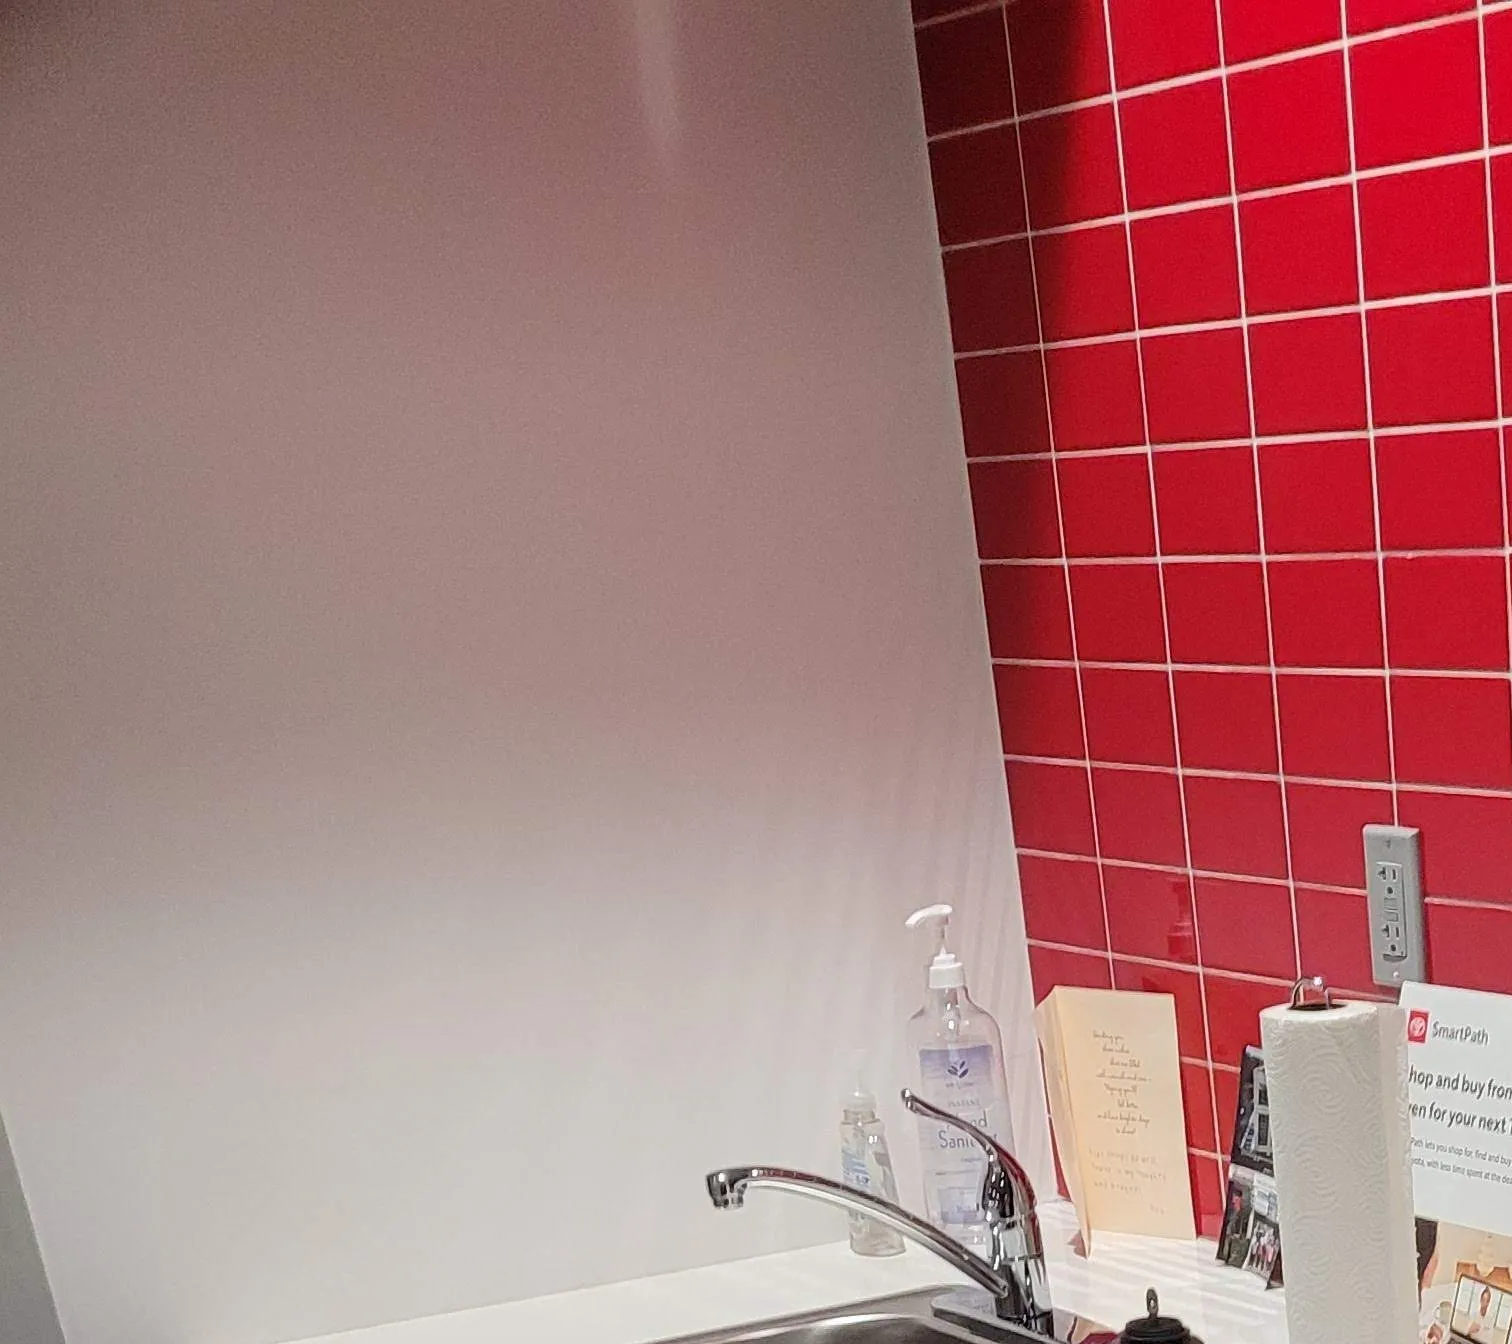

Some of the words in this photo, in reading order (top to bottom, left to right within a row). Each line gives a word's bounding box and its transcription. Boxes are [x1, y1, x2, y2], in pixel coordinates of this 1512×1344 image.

[1432, 1020, 1490, 1046] SmartPath
[1408, 1064, 1433, 1090] hop
[1435, 1072, 1460, 1092] and
[1462, 1074, 1486, 1100] buy
[1428, 1101, 1447, 1122] for
[1447, 1110, 1477, 1128] your
[1478, 1115, 1507, 1135] next
[1426, 1159, 1439, 1169] with
[1440, 1161, 1451, 1172] less
[1452, 1164, 1465, 1175] time
[1436, 1144, 1447, 1153] you
[1448, 1144, 1463, 1157] shop
[1474, 1150, 1487, 1161] find
[1487, 1153, 1500, 1164] and
[1500, 1154, 1512, 1168] buy
